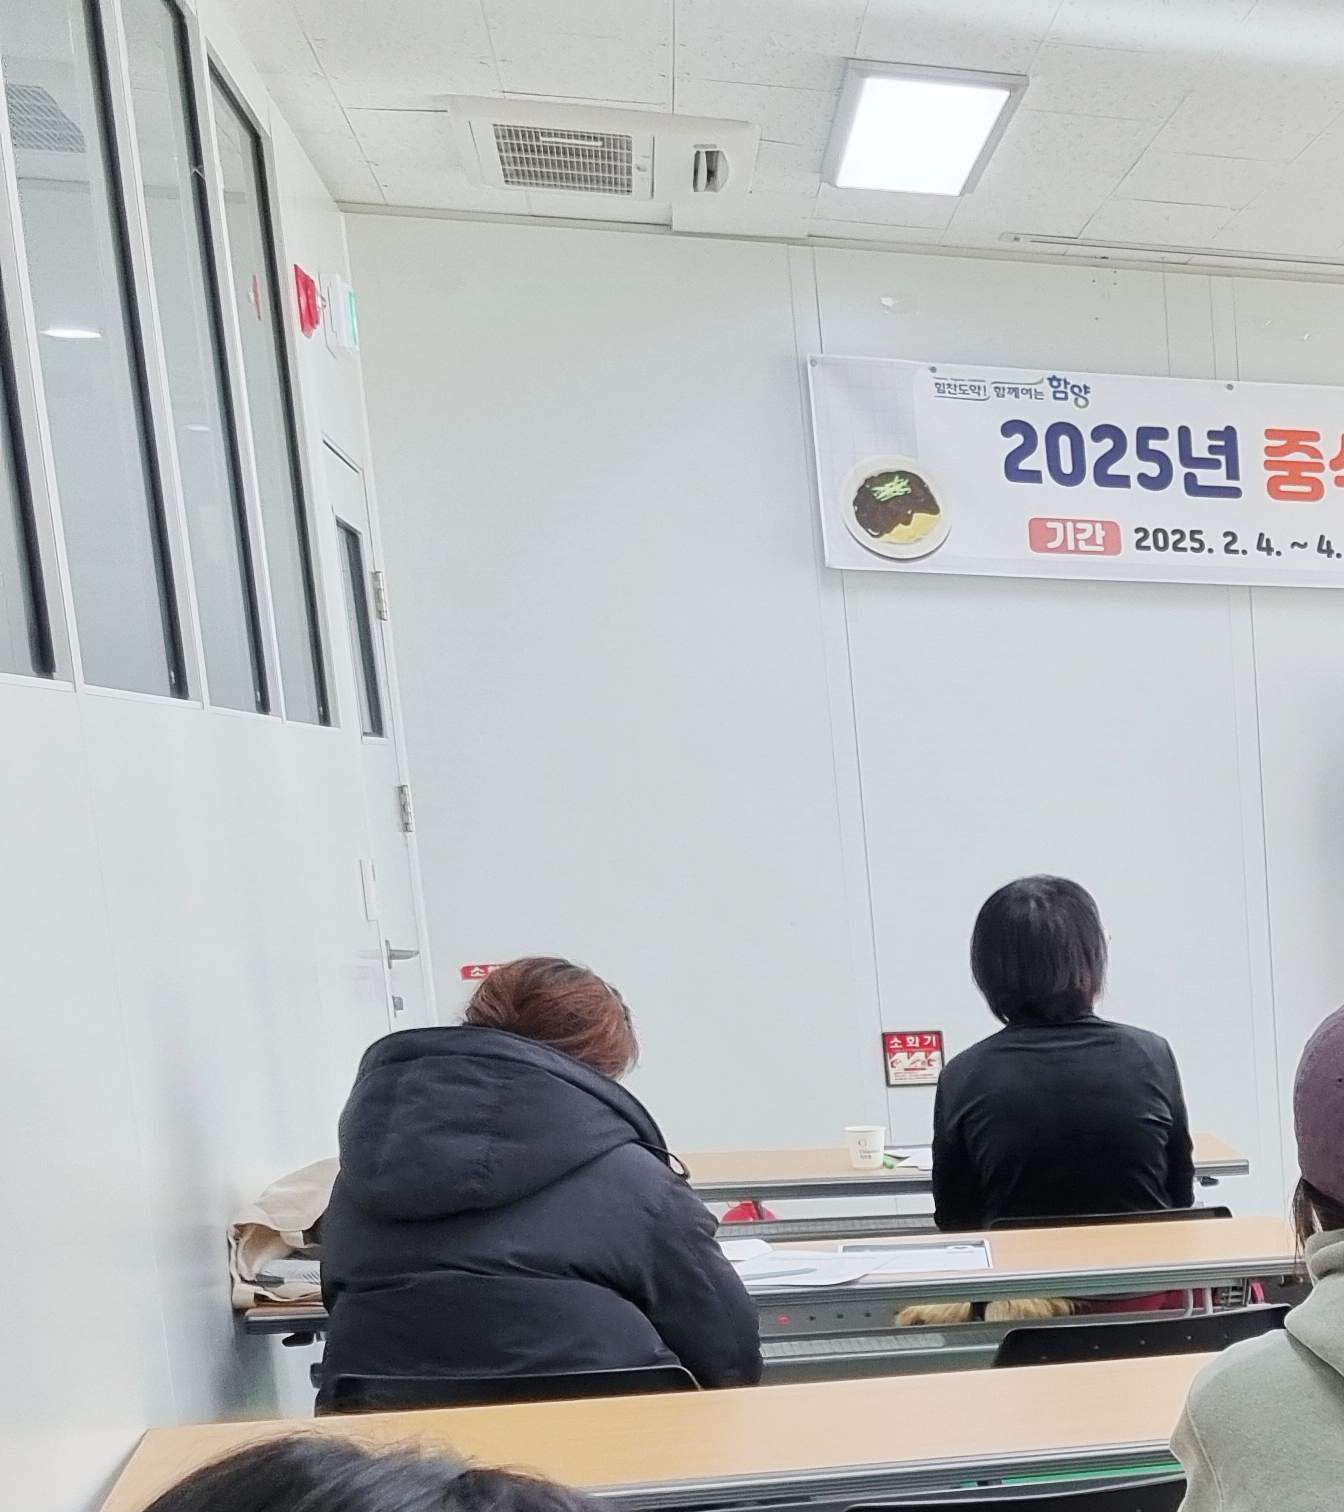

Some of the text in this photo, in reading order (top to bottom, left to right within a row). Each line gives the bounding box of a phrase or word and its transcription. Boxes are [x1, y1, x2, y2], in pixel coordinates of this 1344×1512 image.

[934, 374, 1091, 409] 힘찬도약! 함께여는 함양
[1000, 419, 1242, 499] 2025년
[1046, 521, 1106, 552] 기간
[1134, 527, 1214, 554] 2025.
[1222, 530, 1248, 556] 2.
[1256, 532, 1282, 557] 4.
[1316, 534, 1342, 559] 4.
